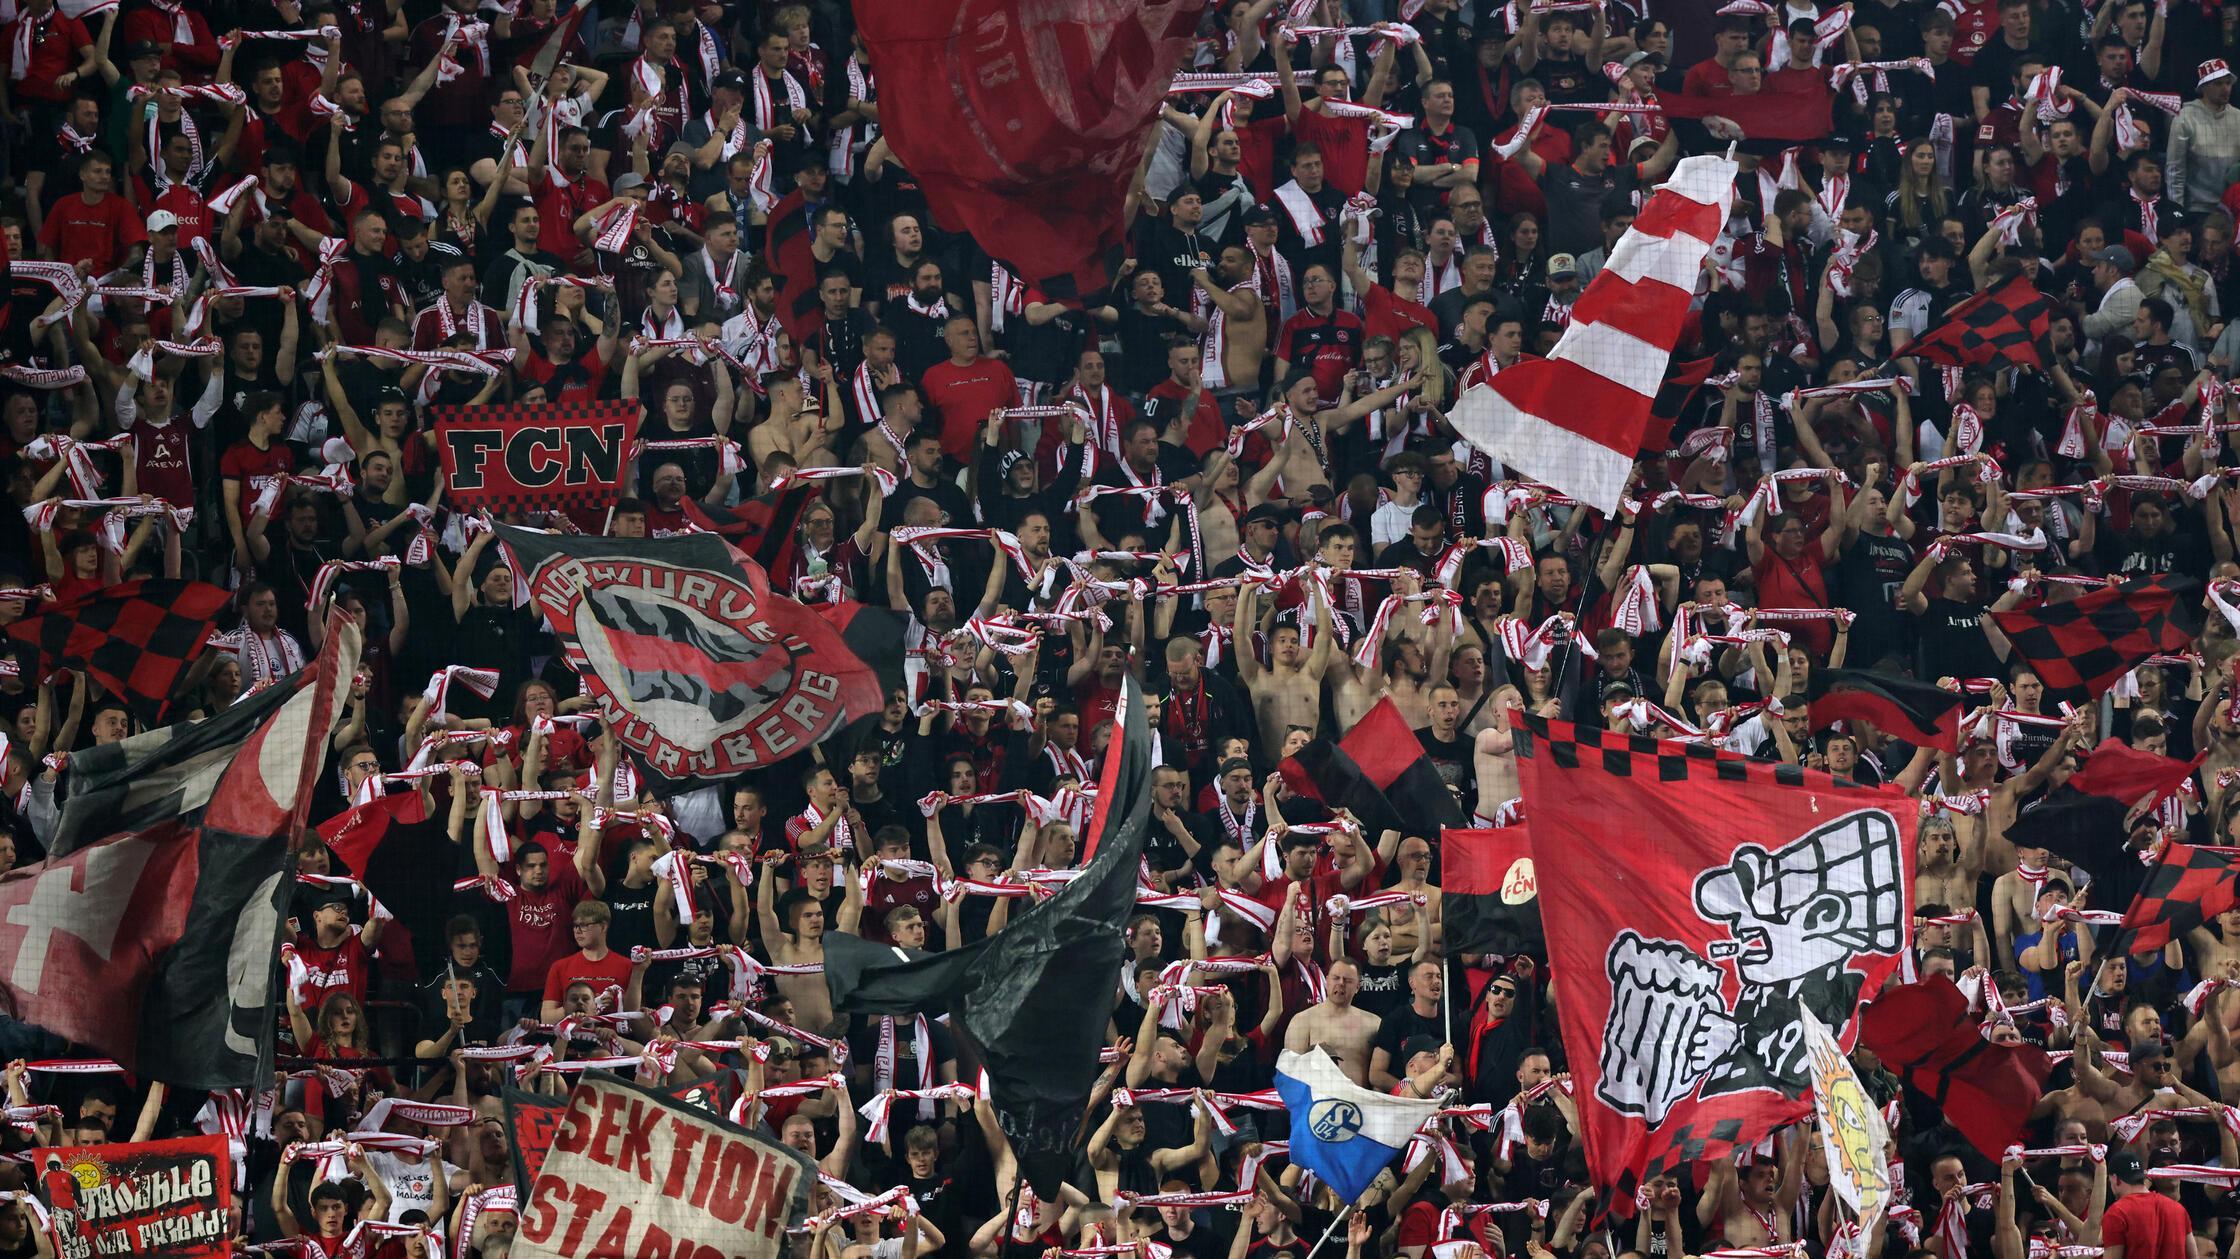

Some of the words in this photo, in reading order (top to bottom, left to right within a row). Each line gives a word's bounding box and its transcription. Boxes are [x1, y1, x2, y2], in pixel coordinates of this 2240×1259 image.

[146, 460, 183, 469] AREVA
[445, 424, 625, 490] FCN
[596, 669, 841, 772] NÜRNBERG
[1504, 876, 1535, 900] FCN
[554, 1084, 796, 1239] SEKTION
